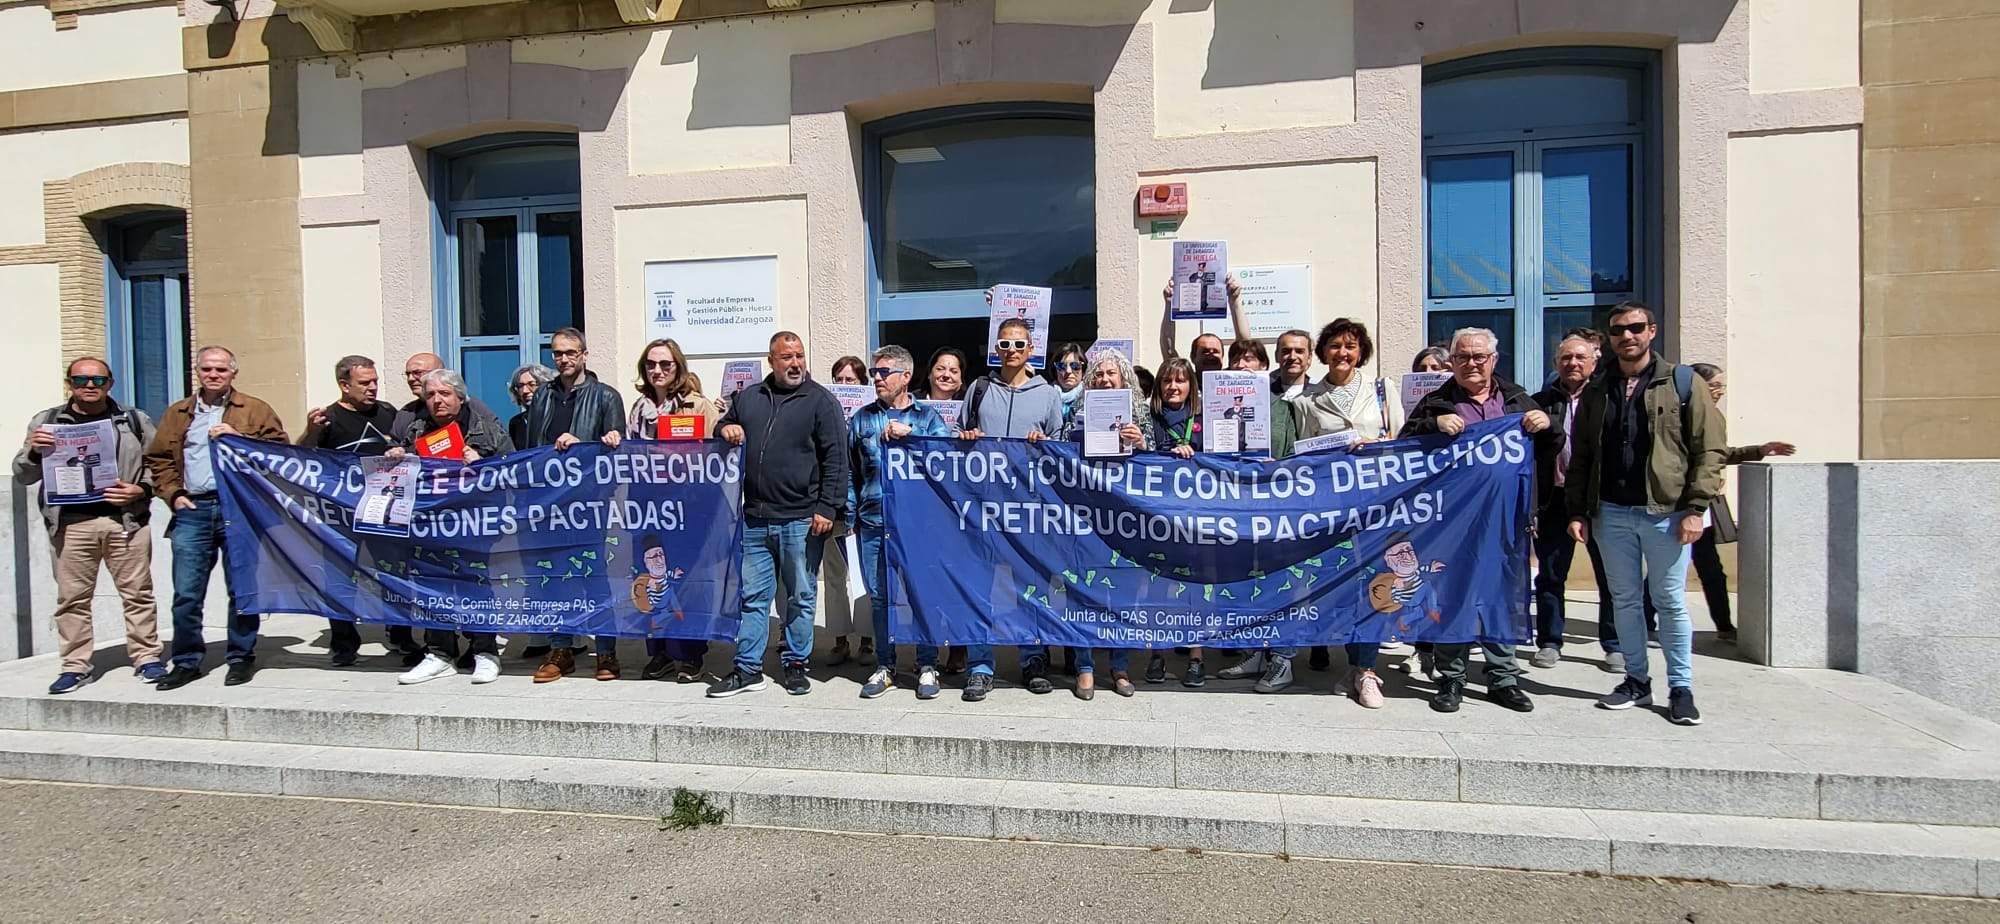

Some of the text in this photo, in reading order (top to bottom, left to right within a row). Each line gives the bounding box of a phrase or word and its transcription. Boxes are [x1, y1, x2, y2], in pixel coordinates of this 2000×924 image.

[687, 297, 715, 305] Facultad
[726, 297, 755, 305] Empresa
[692, 306, 718, 314] Gestión
[719, 304, 744, 313] Pública
[748, 304, 773, 312] Huesca
[1014, 300, 1040, 308] HUELGA
[687, 315, 774, 326] Universidad Zaragoza
[1216, 387, 1257, 395] EN HUELGA
[887, 429, 1525, 500] RECTOR, ¡CUMPLE CON LOS DERECHOS
[458, 463, 519, 495] CON
[526, 457, 583, 492] LOS
[595, 452, 741, 485] DERECHOS
[528, 500, 685, 532] PACTADAS!
[952, 489, 1443, 546] Y RETRIBUCIONES PACTADAS!
[428, 597, 454, 609] PAS
[461, 597, 502, 610] Comité
[505, 598, 519, 610] de
[522, 598, 570, 613] Empresa
[573, 598, 596, 612] PAS
[488, 613, 504, 625] DE
[506, 613, 564, 626] ZARAGOZA
[1061, 605, 1319, 628] Junta de PAS Comité de Empresa PAS
[1097, 626, 1281, 643] UNIVERSIDAD DE ZARAGOZA
